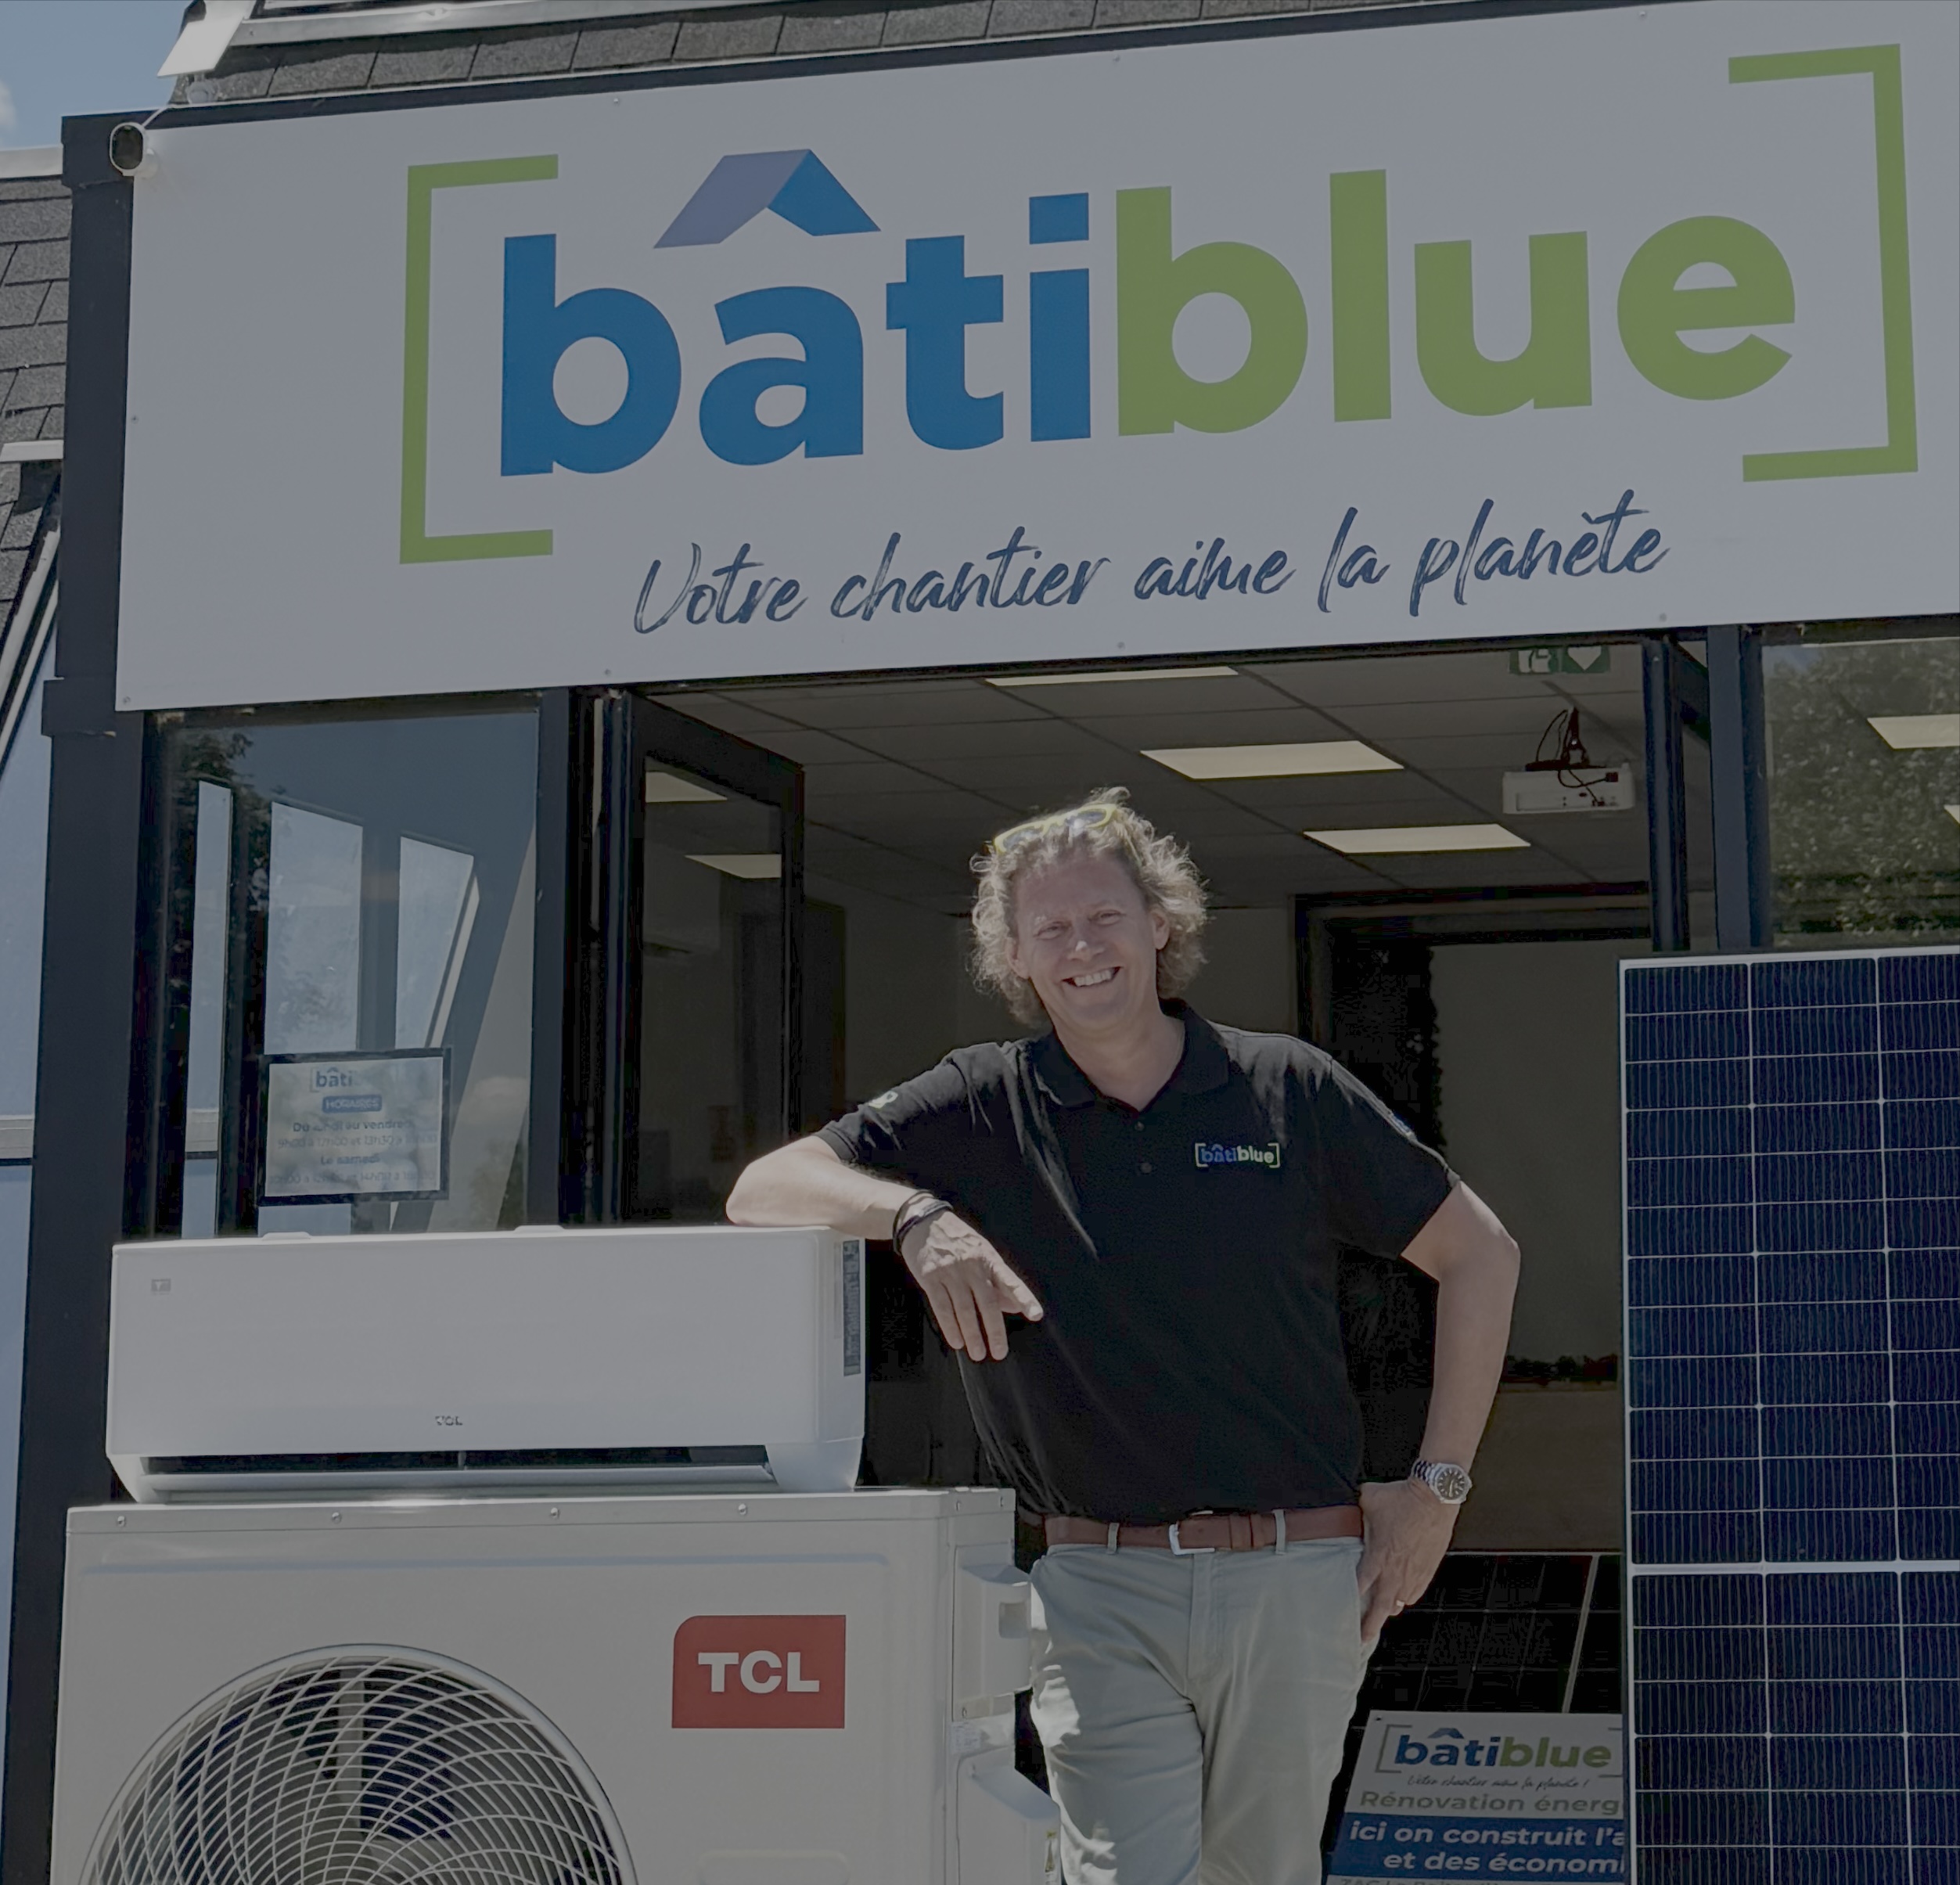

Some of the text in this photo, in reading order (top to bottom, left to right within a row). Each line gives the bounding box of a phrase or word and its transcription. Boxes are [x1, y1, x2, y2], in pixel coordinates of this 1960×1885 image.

[499, 149, 1796, 477] bâtiblue
[635, 490, 1669, 635] Votre chantier aime la planète
[293, 1122, 309, 1132] Du
[363, 1120, 412, 1130] vendred
[434, 1415, 463, 1426] TCL
[698, 1650, 819, 1693] TCL
[1394, 1727, 1612, 1768] bâtiblue
[1359, 1790, 1620, 1815] Rénovation énerg
[1349, 1821, 1387, 1841] ici
[1394, 1826, 1433, 1843] on
[1443, 1825, 1587, 1846] construit
[1383, 1853, 1416, 1870] et
[1424, 1851, 1480, 1871] des
